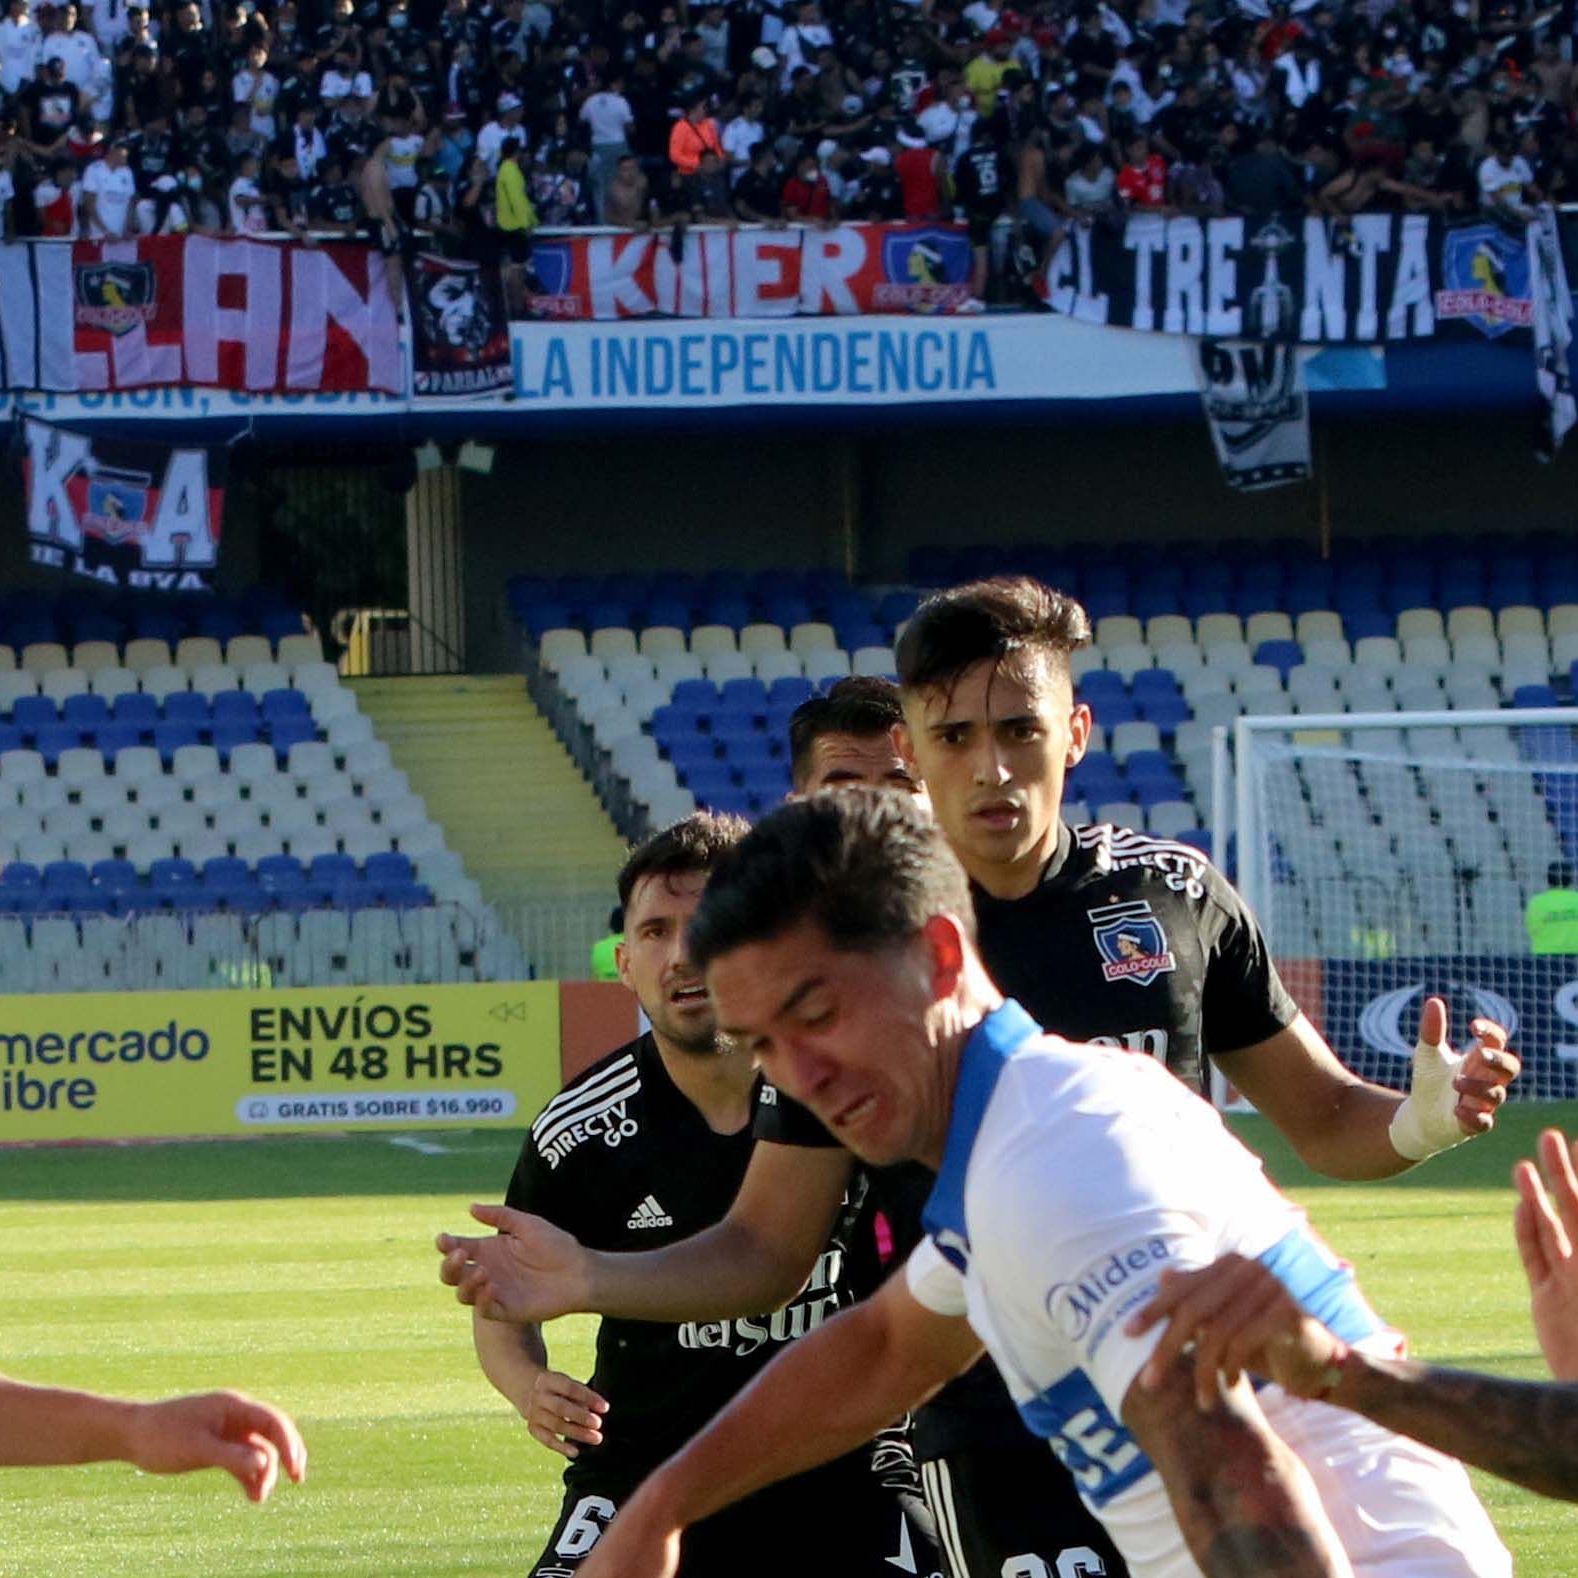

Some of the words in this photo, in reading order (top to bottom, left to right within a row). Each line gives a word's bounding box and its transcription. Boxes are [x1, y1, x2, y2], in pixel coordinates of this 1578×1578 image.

[515, 337, 573, 399] LA
[590, 331, 997, 397] INDEPENDENCIA
[1165, 872, 1205, 899] GO
[1107, 953, 1176, 978] COLO-COLO
[250, 996, 431, 1041] ENVÍOS
[252, 1047, 318, 1084] EN
[330, 1045, 388, 1081] 48
[406, 1041, 502, 1079] HRS
[278, 1101, 347, 1120] GRATIS
[353, 1099, 420, 1119] SOBRE
[427, 1098, 503, 1117] $16.990
[539, 1101, 627, 1169] DIRECTV
[604, 1119, 638, 1148] GO
[627, 1215, 673, 1229] adidas
[1046, 1238, 1169, 1342] Midea
[678, 1320, 731, 1349] del
[555, 1495, 618, 1559] 6
